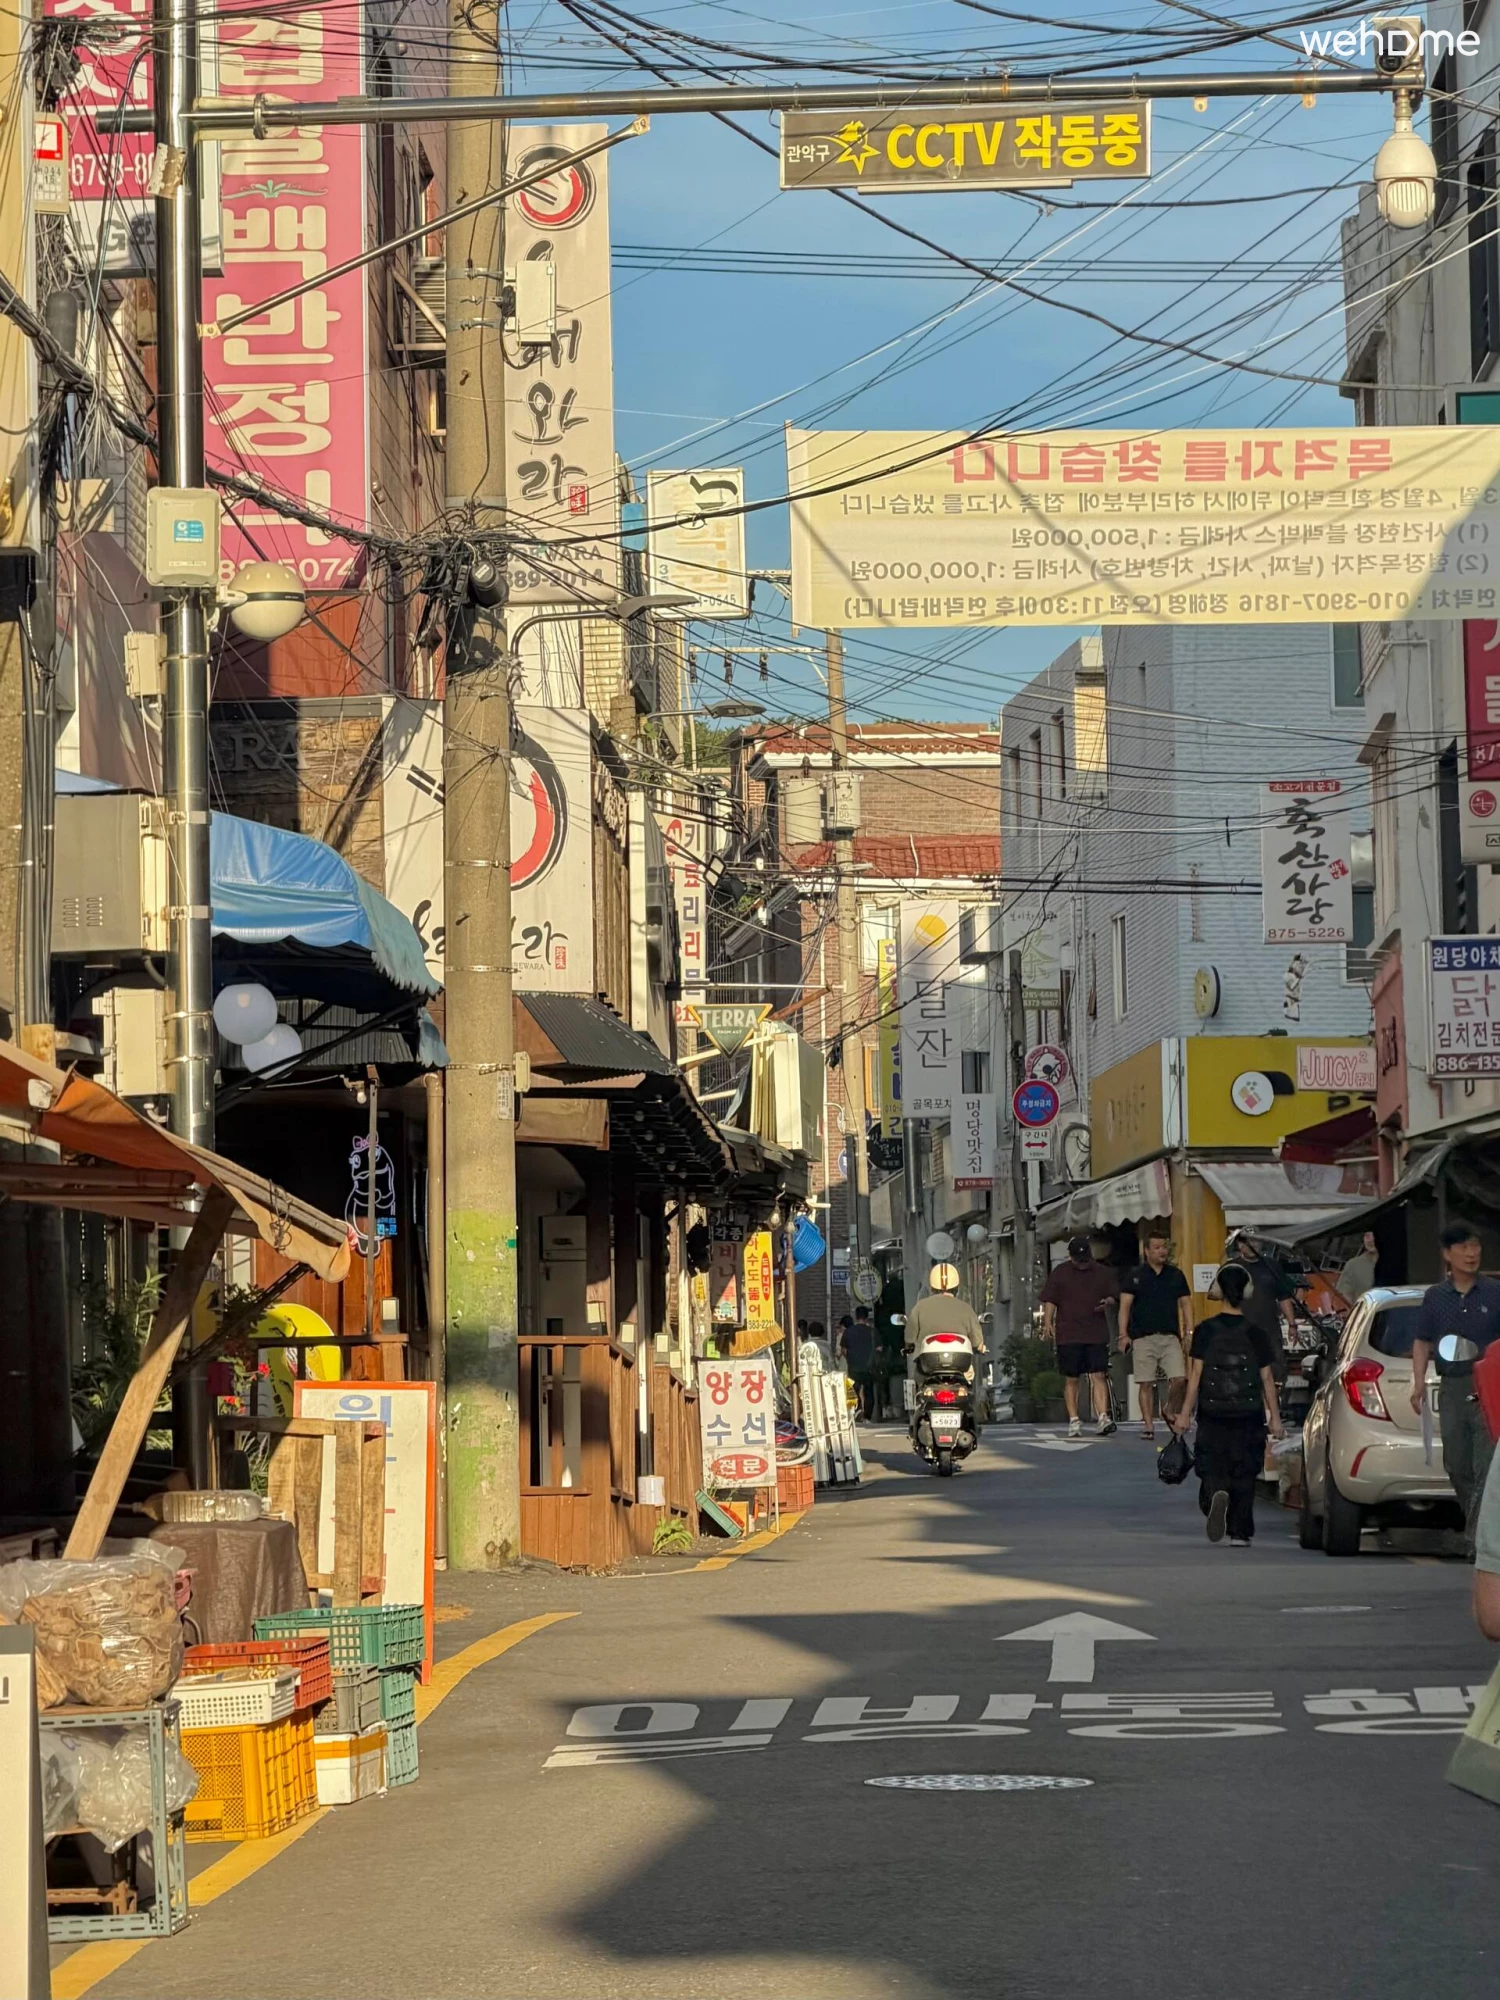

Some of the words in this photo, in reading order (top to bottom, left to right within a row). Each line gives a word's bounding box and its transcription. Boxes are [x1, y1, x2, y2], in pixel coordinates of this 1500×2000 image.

[786, 145, 831, 163] 관악구
[886, 121, 1005, 169] CCTV
[1014, 113, 1142, 169] 작동중
[1267, 927, 1345, 939] 875-5226
[698, 1009, 758, 1030] TERRA
[916, 979, 952, 1068] 달잔
[1303, 1049, 1357, 1087] JUICY
[965, 1100, 984, 1174] 명당맛집
[706, 1370, 767, 1405] 양장
[707, 1412, 767, 1446] 수선
[719, 1459, 760, 1474] 전문
[541, 1683, 1488, 1767] 일방통행
